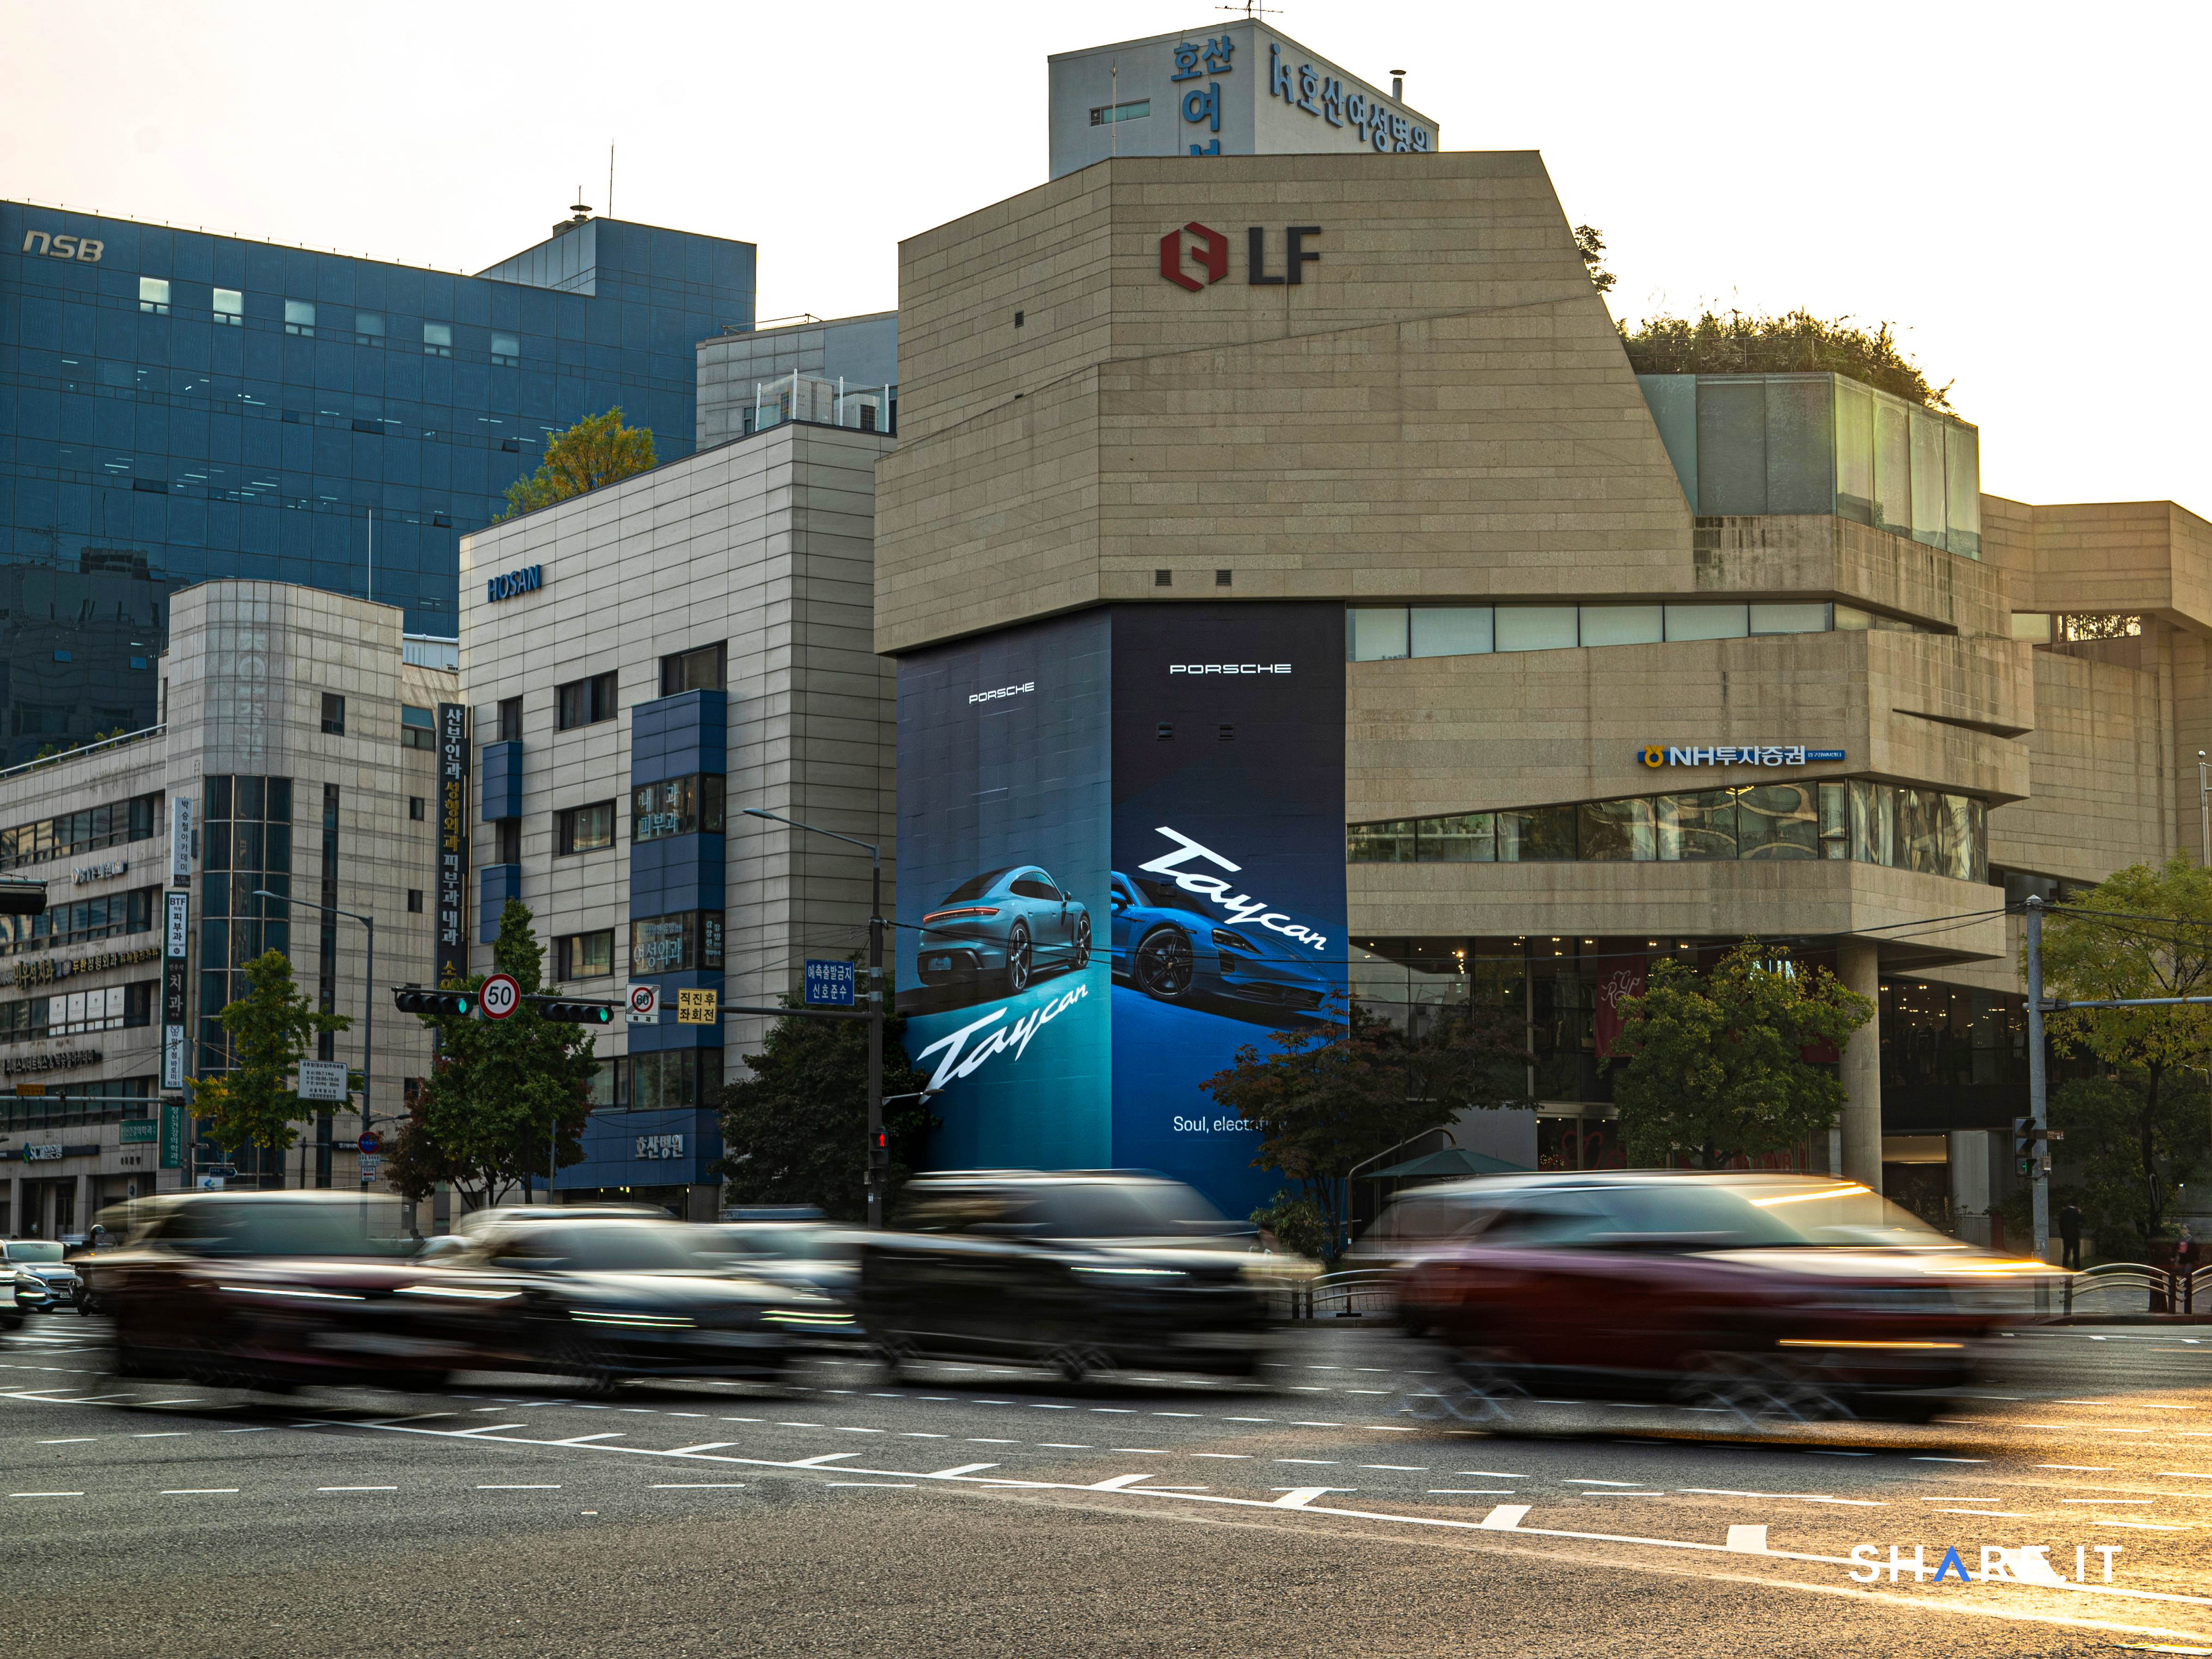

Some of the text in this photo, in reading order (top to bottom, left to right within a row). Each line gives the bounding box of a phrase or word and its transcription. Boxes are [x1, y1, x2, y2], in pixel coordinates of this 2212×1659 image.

[1171, 35, 1234, 81] 호산
[1249, 226, 1321, 285] LF
[488, 564, 542, 603] HOSAN
[1169, 664, 1292, 674] PORSCHE
[969, 682, 1035, 704] PORSCHE
[445, 708, 463, 780] 산부인과
[1670, 745, 1805, 766] NH투자증권
[444, 781, 460, 852] 성형외과
[640, 809, 679, 839] 피부과
[181, 799, 189, 872] 박승철아카데미
[443, 854, 459, 907] 피부과
[1138, 826, 1327, 951] Taycan
[169, 898, 186, 906] BTF
[172, 912, 183, 941] 피부과
[442, 910, 459, 947] 내과
[633, 938, 682, 968] 여성외과
[808, 965, 852, 981] 예측출발금지
[169, 974, 184, 1012] 치과
[487, 986, 512, 1005] 50
[637, 995, 649, 1005] 60
[680, 992, 715, 1006] 직진후
[813, 984, 847, 1000] 신호준수
[680, 1008, 714, 1022] 좌회전
[916, 982, 1088, 1104] Taycan
[1174, 1116, 1209, 1134] Soul,
[635, 1134, 683, 1159] 호산병원
